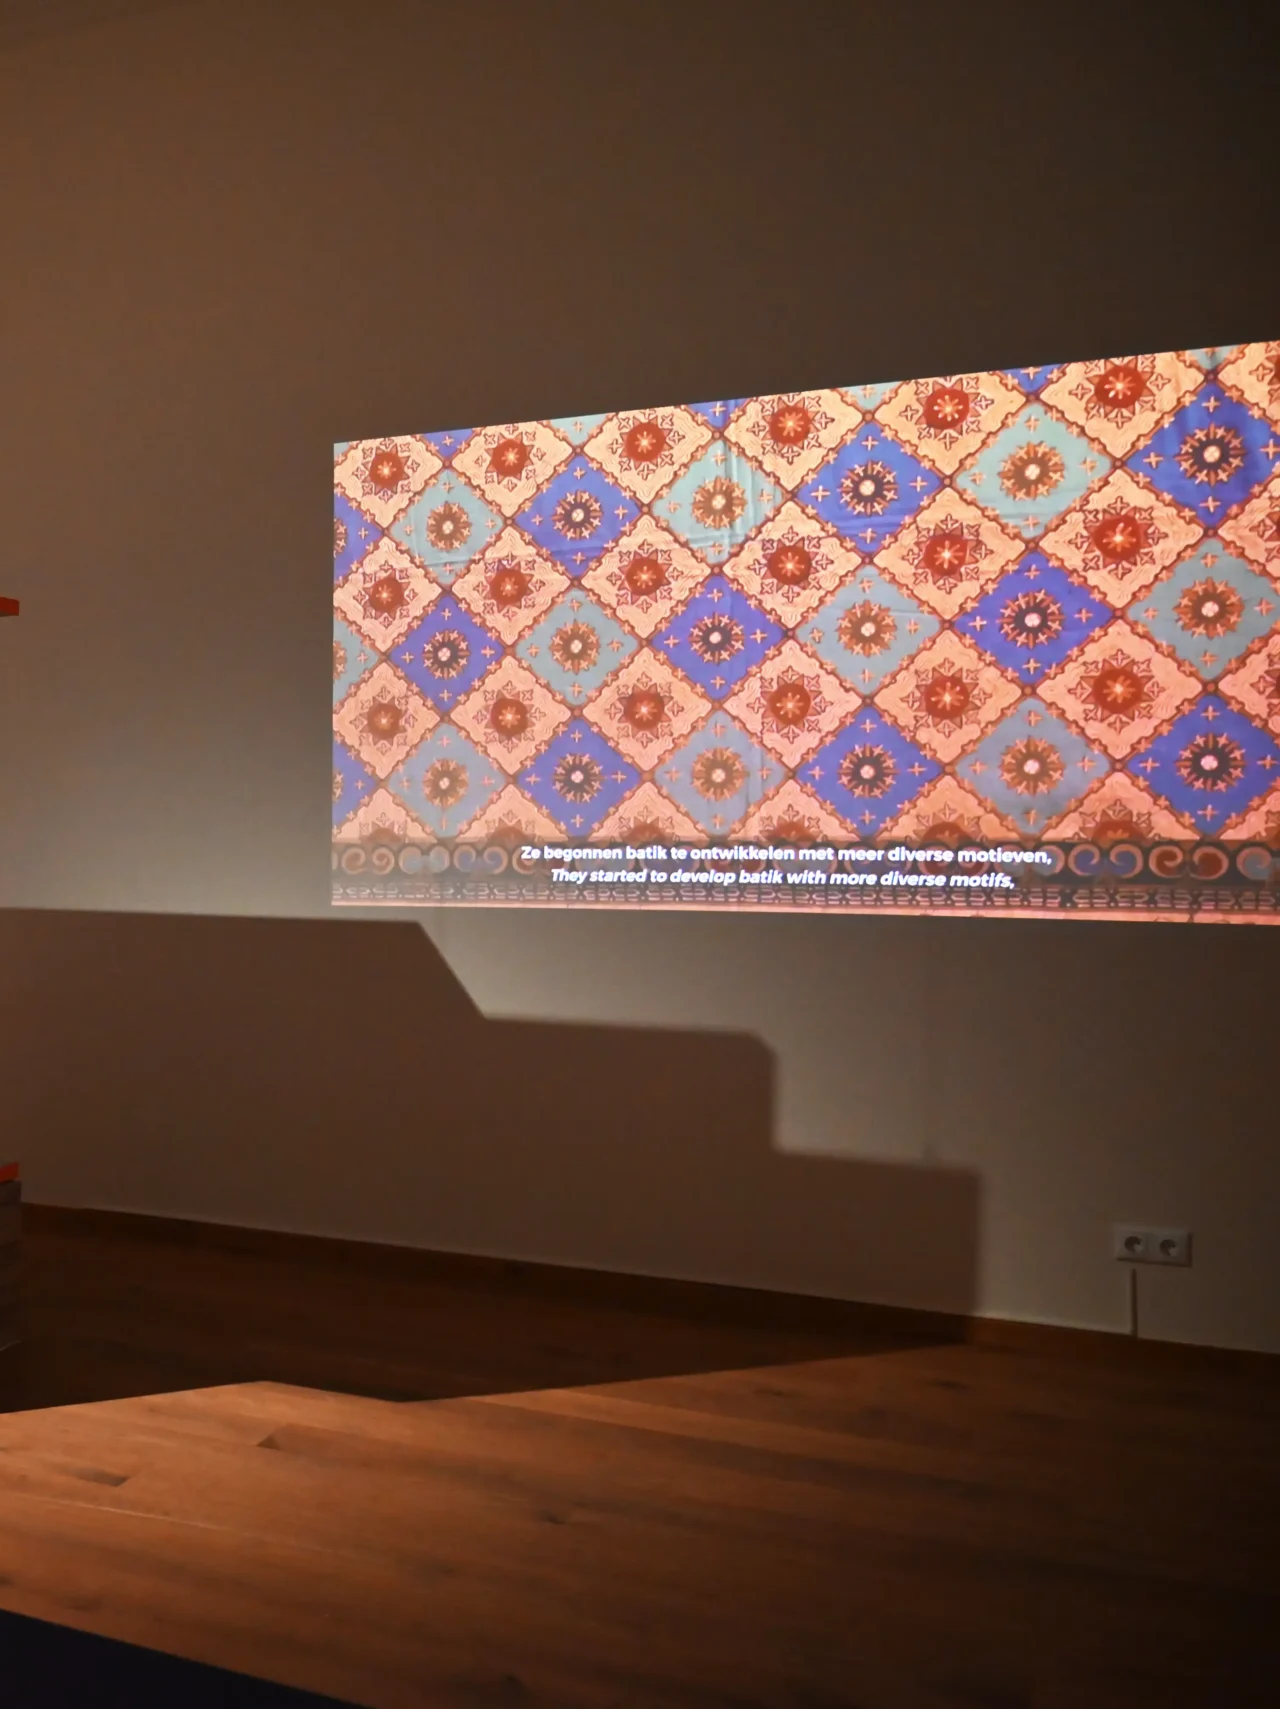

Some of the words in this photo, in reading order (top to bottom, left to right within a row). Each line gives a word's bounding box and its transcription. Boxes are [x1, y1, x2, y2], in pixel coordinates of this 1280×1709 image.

[521, 846, 540, 859] Ze
[544, 846, 621, 862] begonnen
[627, 846, 666, 859] batik
[671, 848, 686, 859] te
[690, 846, 794, 860] ontwikkelen
[799, 848, 833, 860] met
[838, 850, 884, 861] meer
[888, 847, 953, 861] diverse
[958, 847, 1051, 865] motieven,
[552, 869, 587, 884] They
[590, 869, 646, 882] started
[650, 870, 667, 882] to
[670, 869, 736, 885] develop
[740, 870, 782, 883] batik
[788, 870, 826, 884] with
[830, 873, 877, 885] more
[881, 872, 946, 886] diverse
[950, 872, 1014, 890] motifs,
